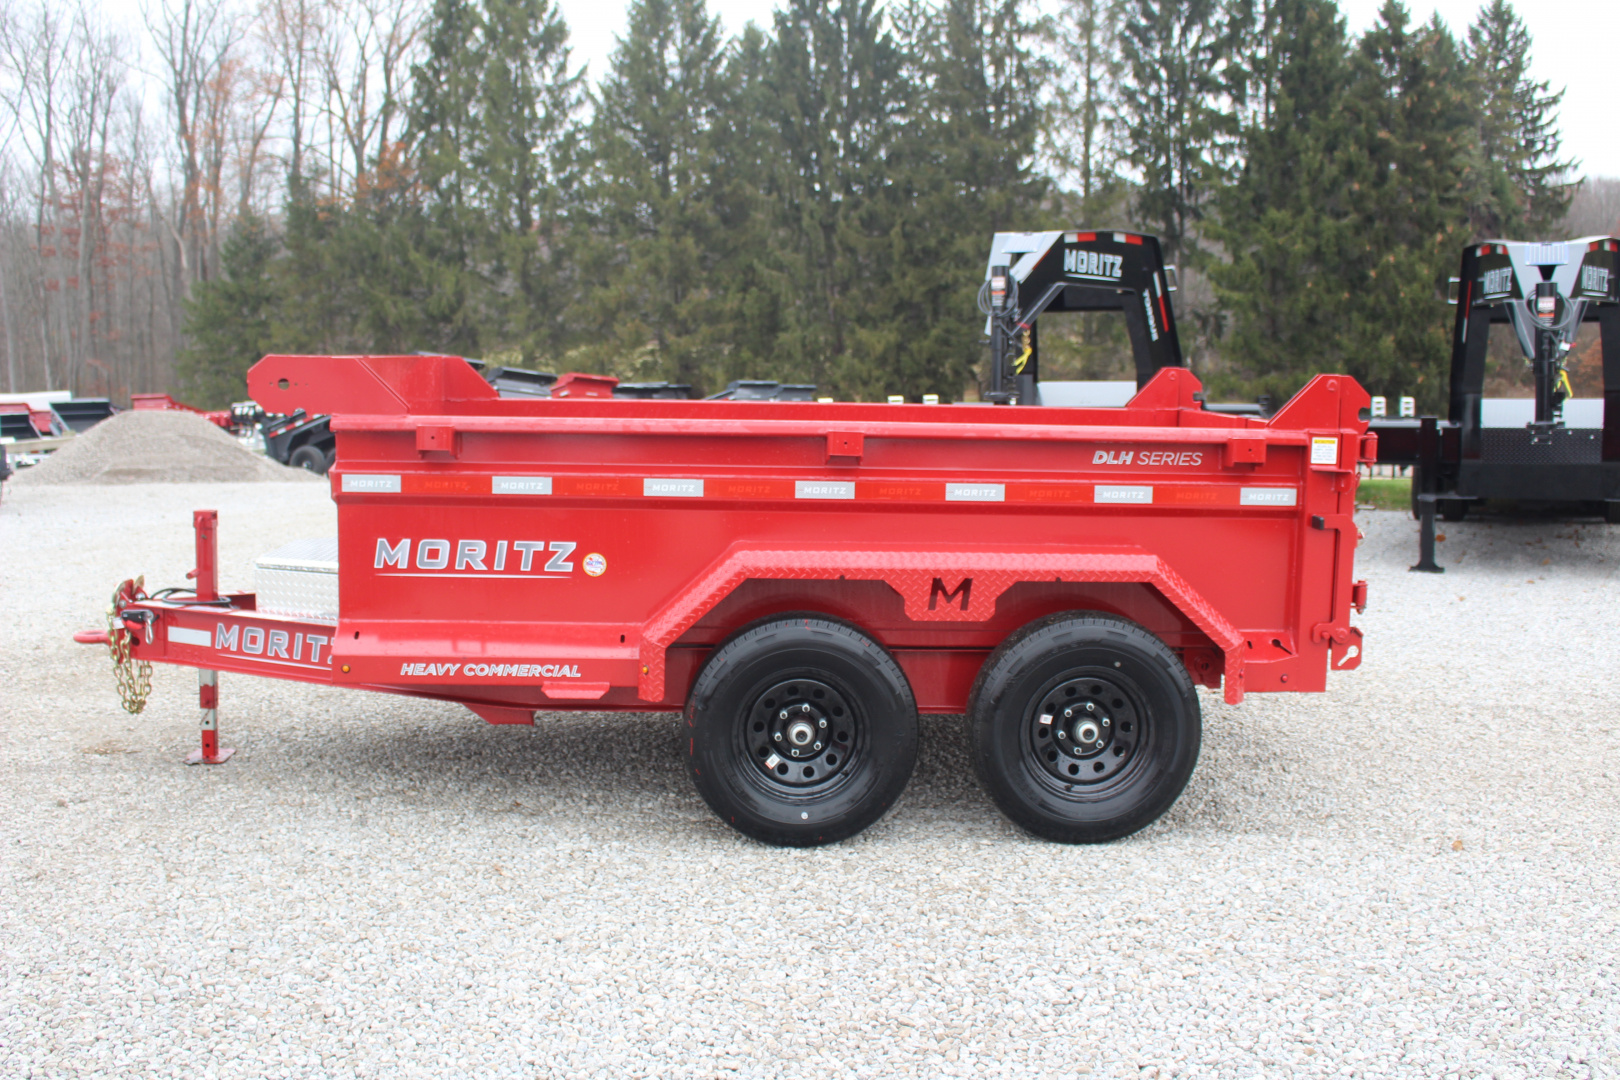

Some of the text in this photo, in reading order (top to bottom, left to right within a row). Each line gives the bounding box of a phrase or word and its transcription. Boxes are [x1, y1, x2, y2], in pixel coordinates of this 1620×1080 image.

[1064, 248, 1123, 277] MORITZ
[1484, 266, 1513, 294] MORITZ
[1582, 264, 1609, 292] MORITZ
[1092, 450, 1203, 466] DLH SERIES
[350, 480, 393, 488] MORITZ
[500, 481, 544, 490] MORITZ
[576, 482, 619, 491] MORITZ
[652, 483, 695, 492] MORITZ
[728, 485, 771, 493] MORITZ
[803, 486, 847, 494] MORITZ
[879, 487, 922, 496] MORITZ
[954, 488, 996, 497] MORITZ
[1102, 490, 1145, 499] MORITZ
[1248, 492, 1290, 501] MORITZ
[373, 538, 577, 572] MORITZ
[928, 577, 973, 611] M
[400, 663, 582, 677] HEAVY COMMERCIAL
